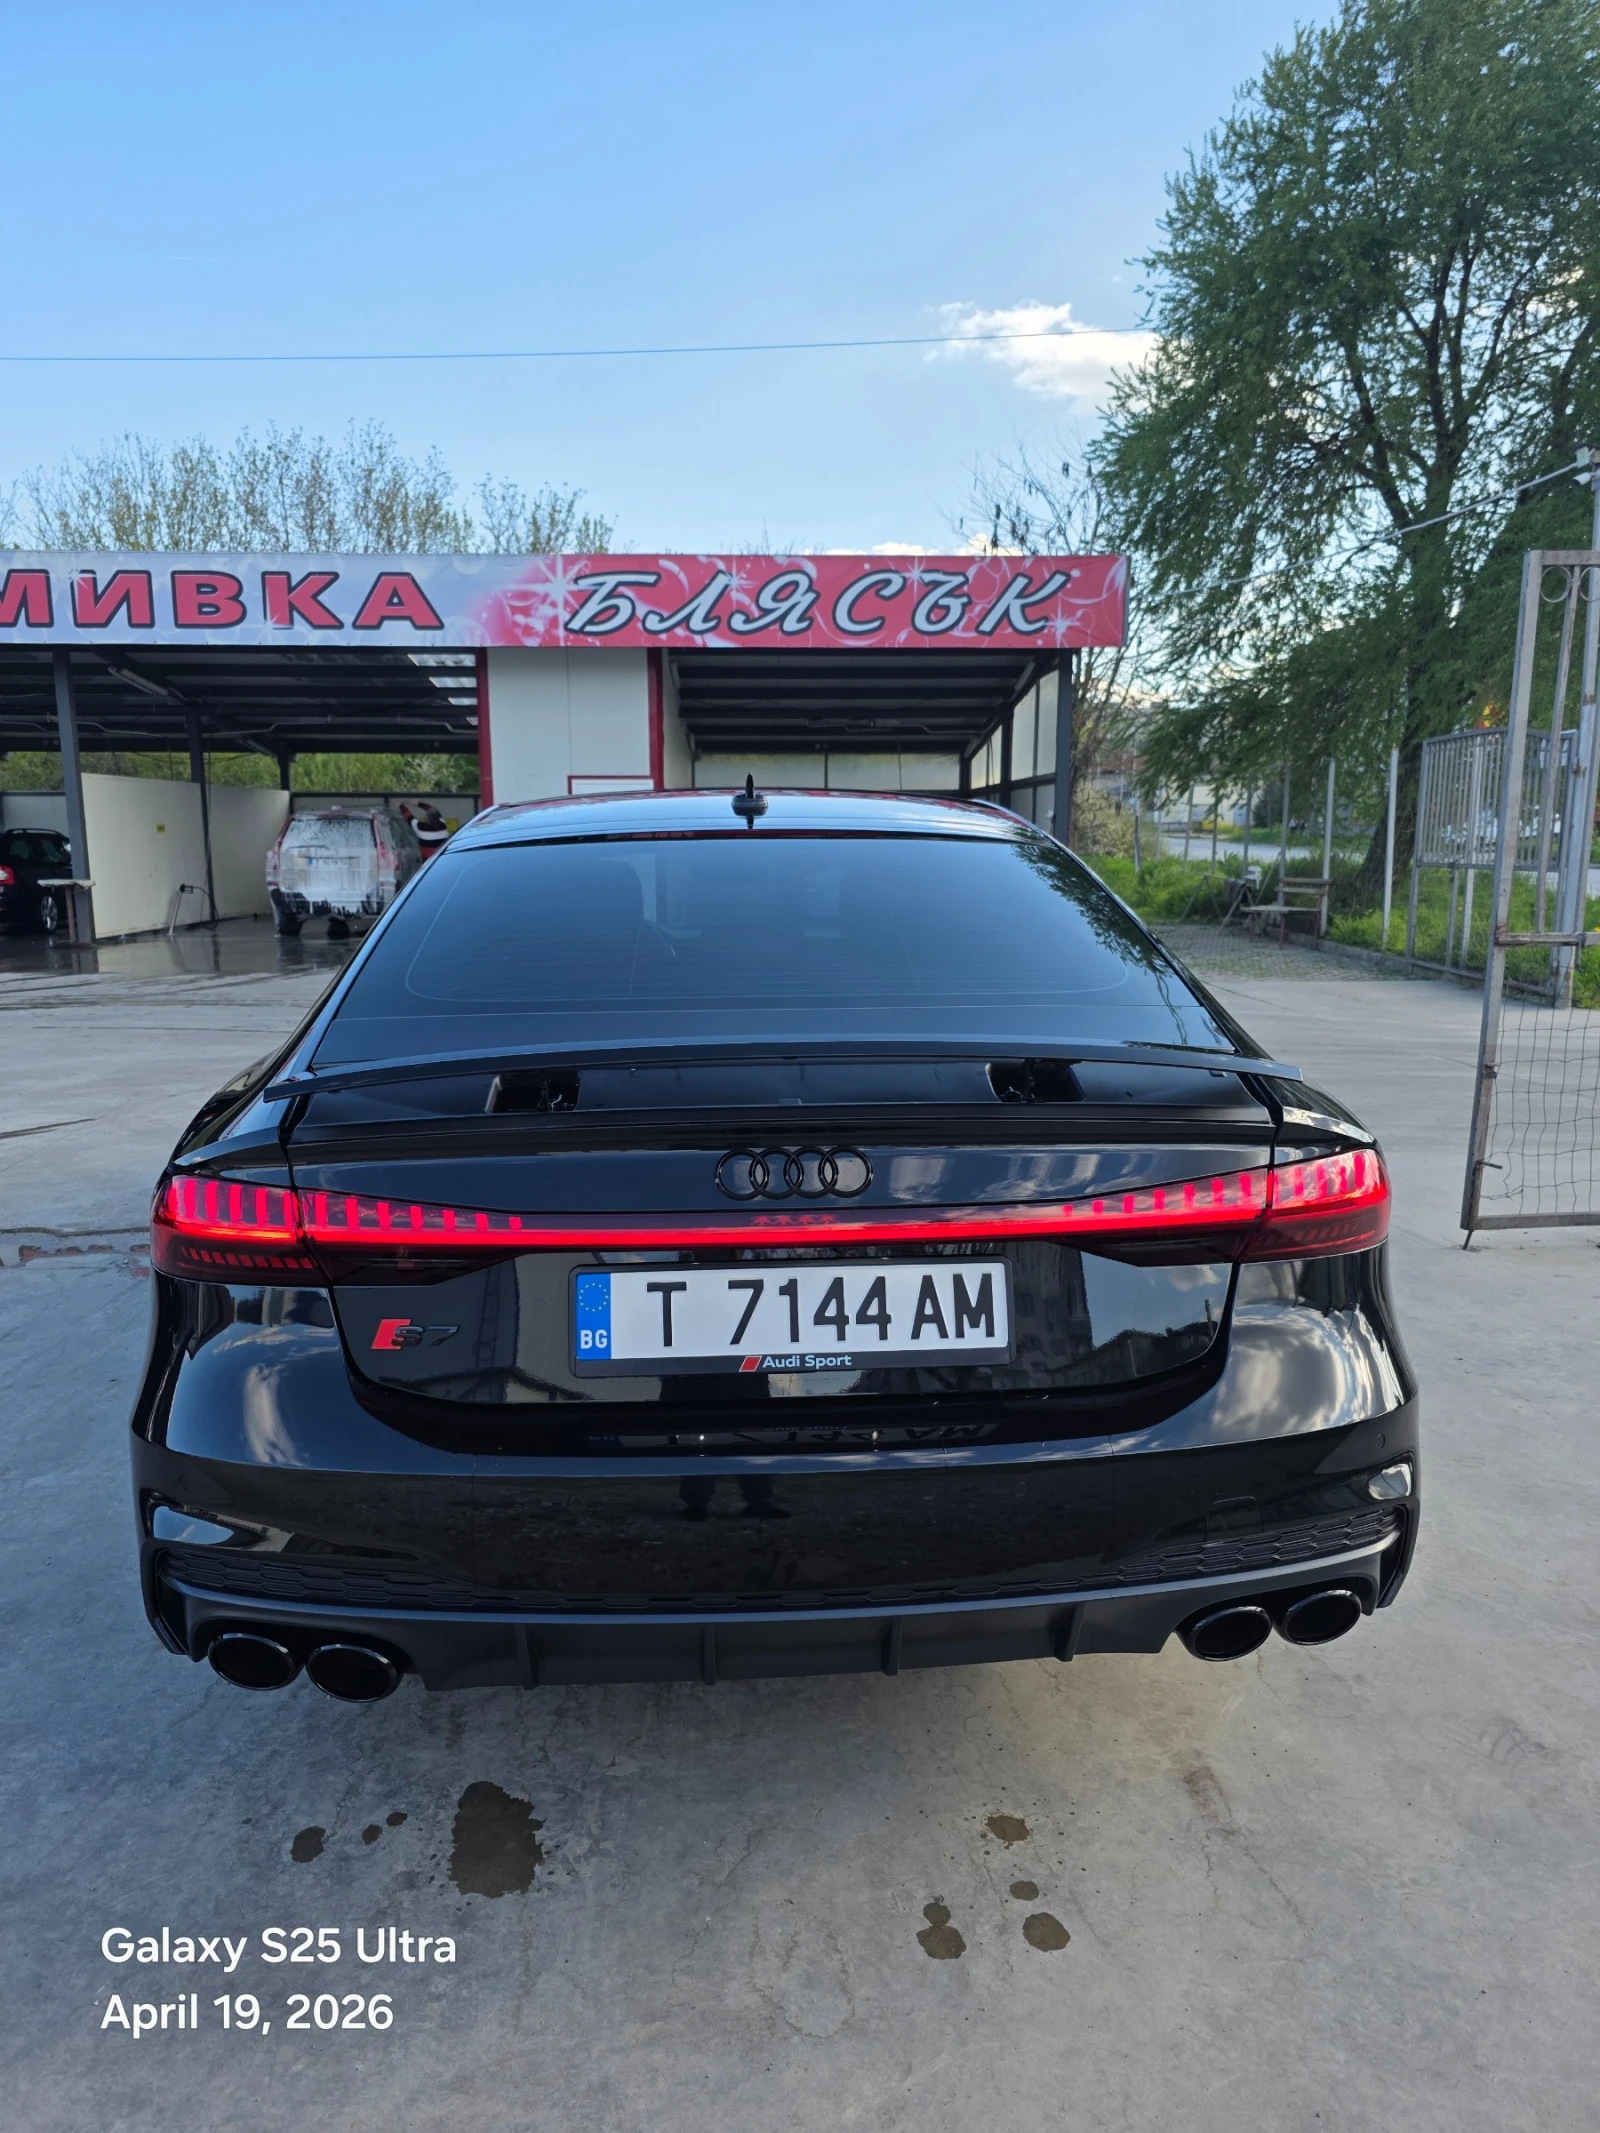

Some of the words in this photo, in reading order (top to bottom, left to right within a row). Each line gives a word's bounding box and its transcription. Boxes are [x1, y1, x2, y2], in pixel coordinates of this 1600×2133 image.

[564, 569, 1071, 637] БЛЯСЪК
[646, 1281, 687, 1348] T
[728, 1275, 892, 1346] 7144
[910, 1273, 996, 1340] AM
[391, 1325, 460, 1347] S7
[580, 1329, 608, 1350] BG
[762, 1355, 800, 1368] Audi
[804, 1354, 852, 1370] Sport
